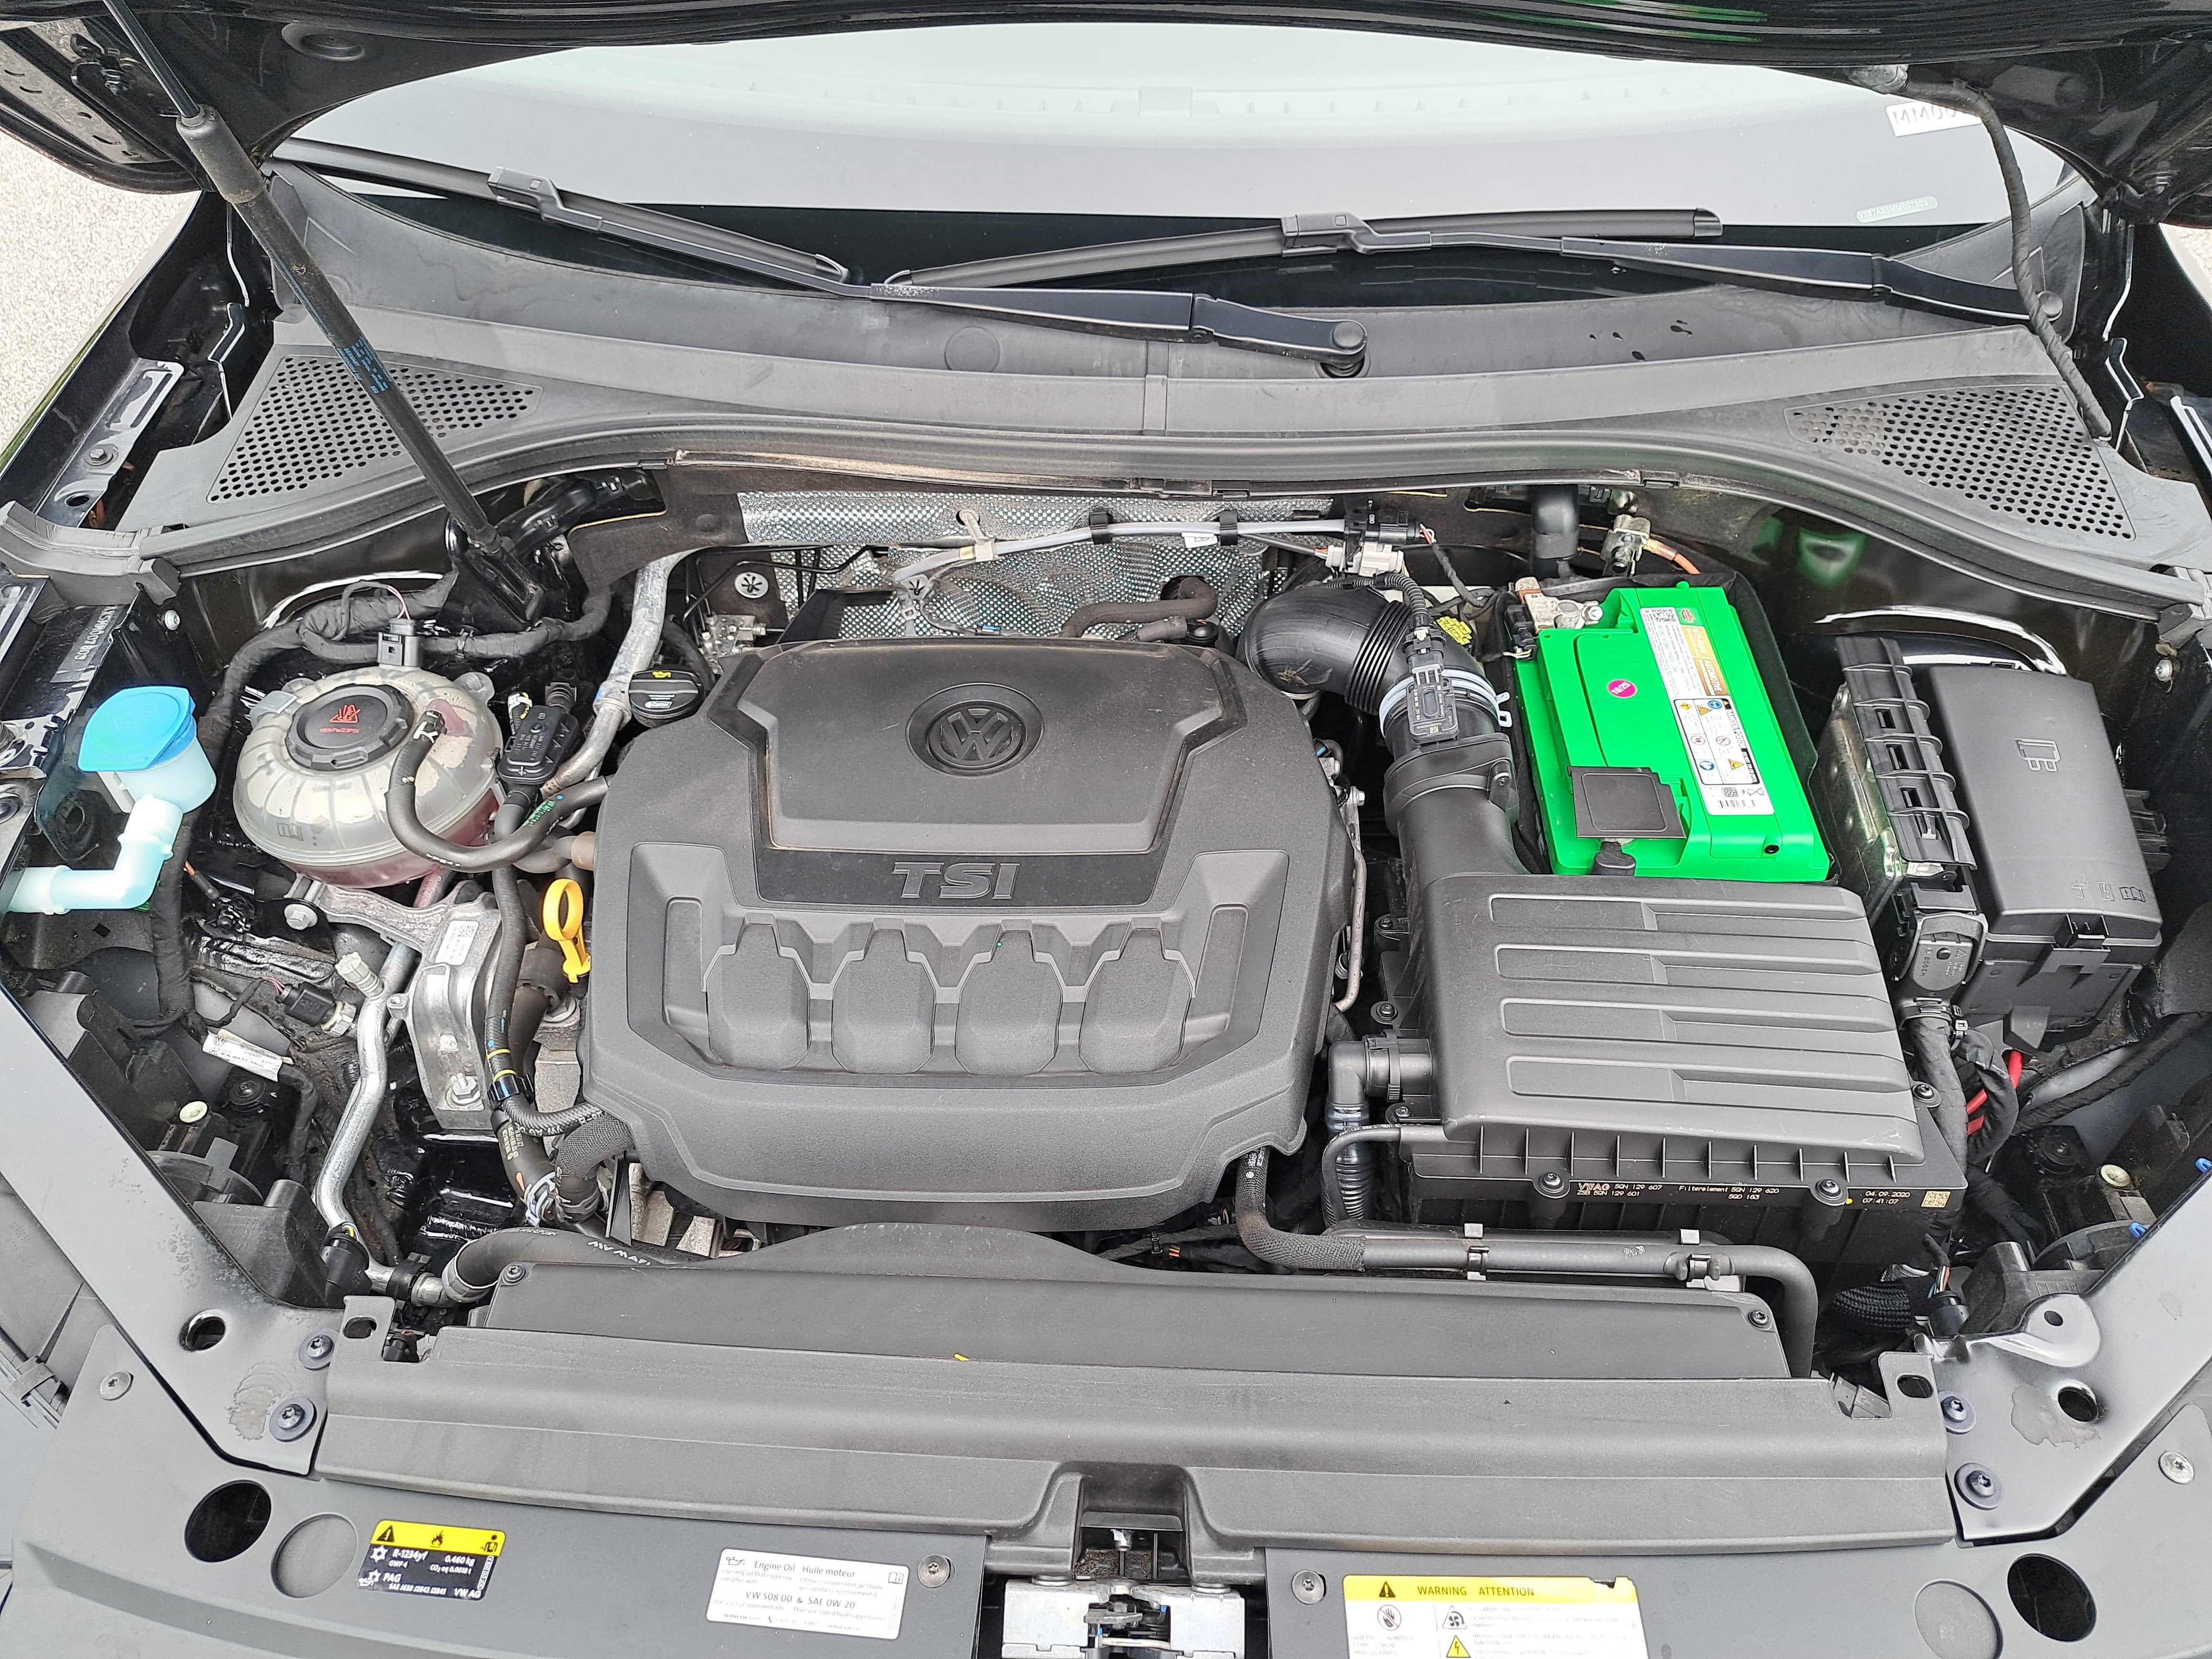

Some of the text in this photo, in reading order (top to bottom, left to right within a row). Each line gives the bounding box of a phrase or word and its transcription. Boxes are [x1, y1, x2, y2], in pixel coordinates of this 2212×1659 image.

[1704, 661, 1723, 692] AUTOMOTIVE
[1611, 682, 1630, 695] 10/25
[892, 862, 1020, 900] TSI
[1920, 957, 1930, 976] BOSCH
[392, 1549, 429, 1562] R-1234yf
[445, 1555, 476, 1567] 0.460 kg
[754, 1560, 782, 1571] Engine
[802, 1565, 856, 1578] Huile moteur
[383, 1572, 402, 1582] PAG
[454, 1587, 481, 1598] VW AG
[1417, 1586, 1535, 1597] WARNING ATTENTION
[763, 1593, 779, 1601] 508
[781, 1594, 793, 1603] 00
[808, 1597, 823, 1605] SAE
